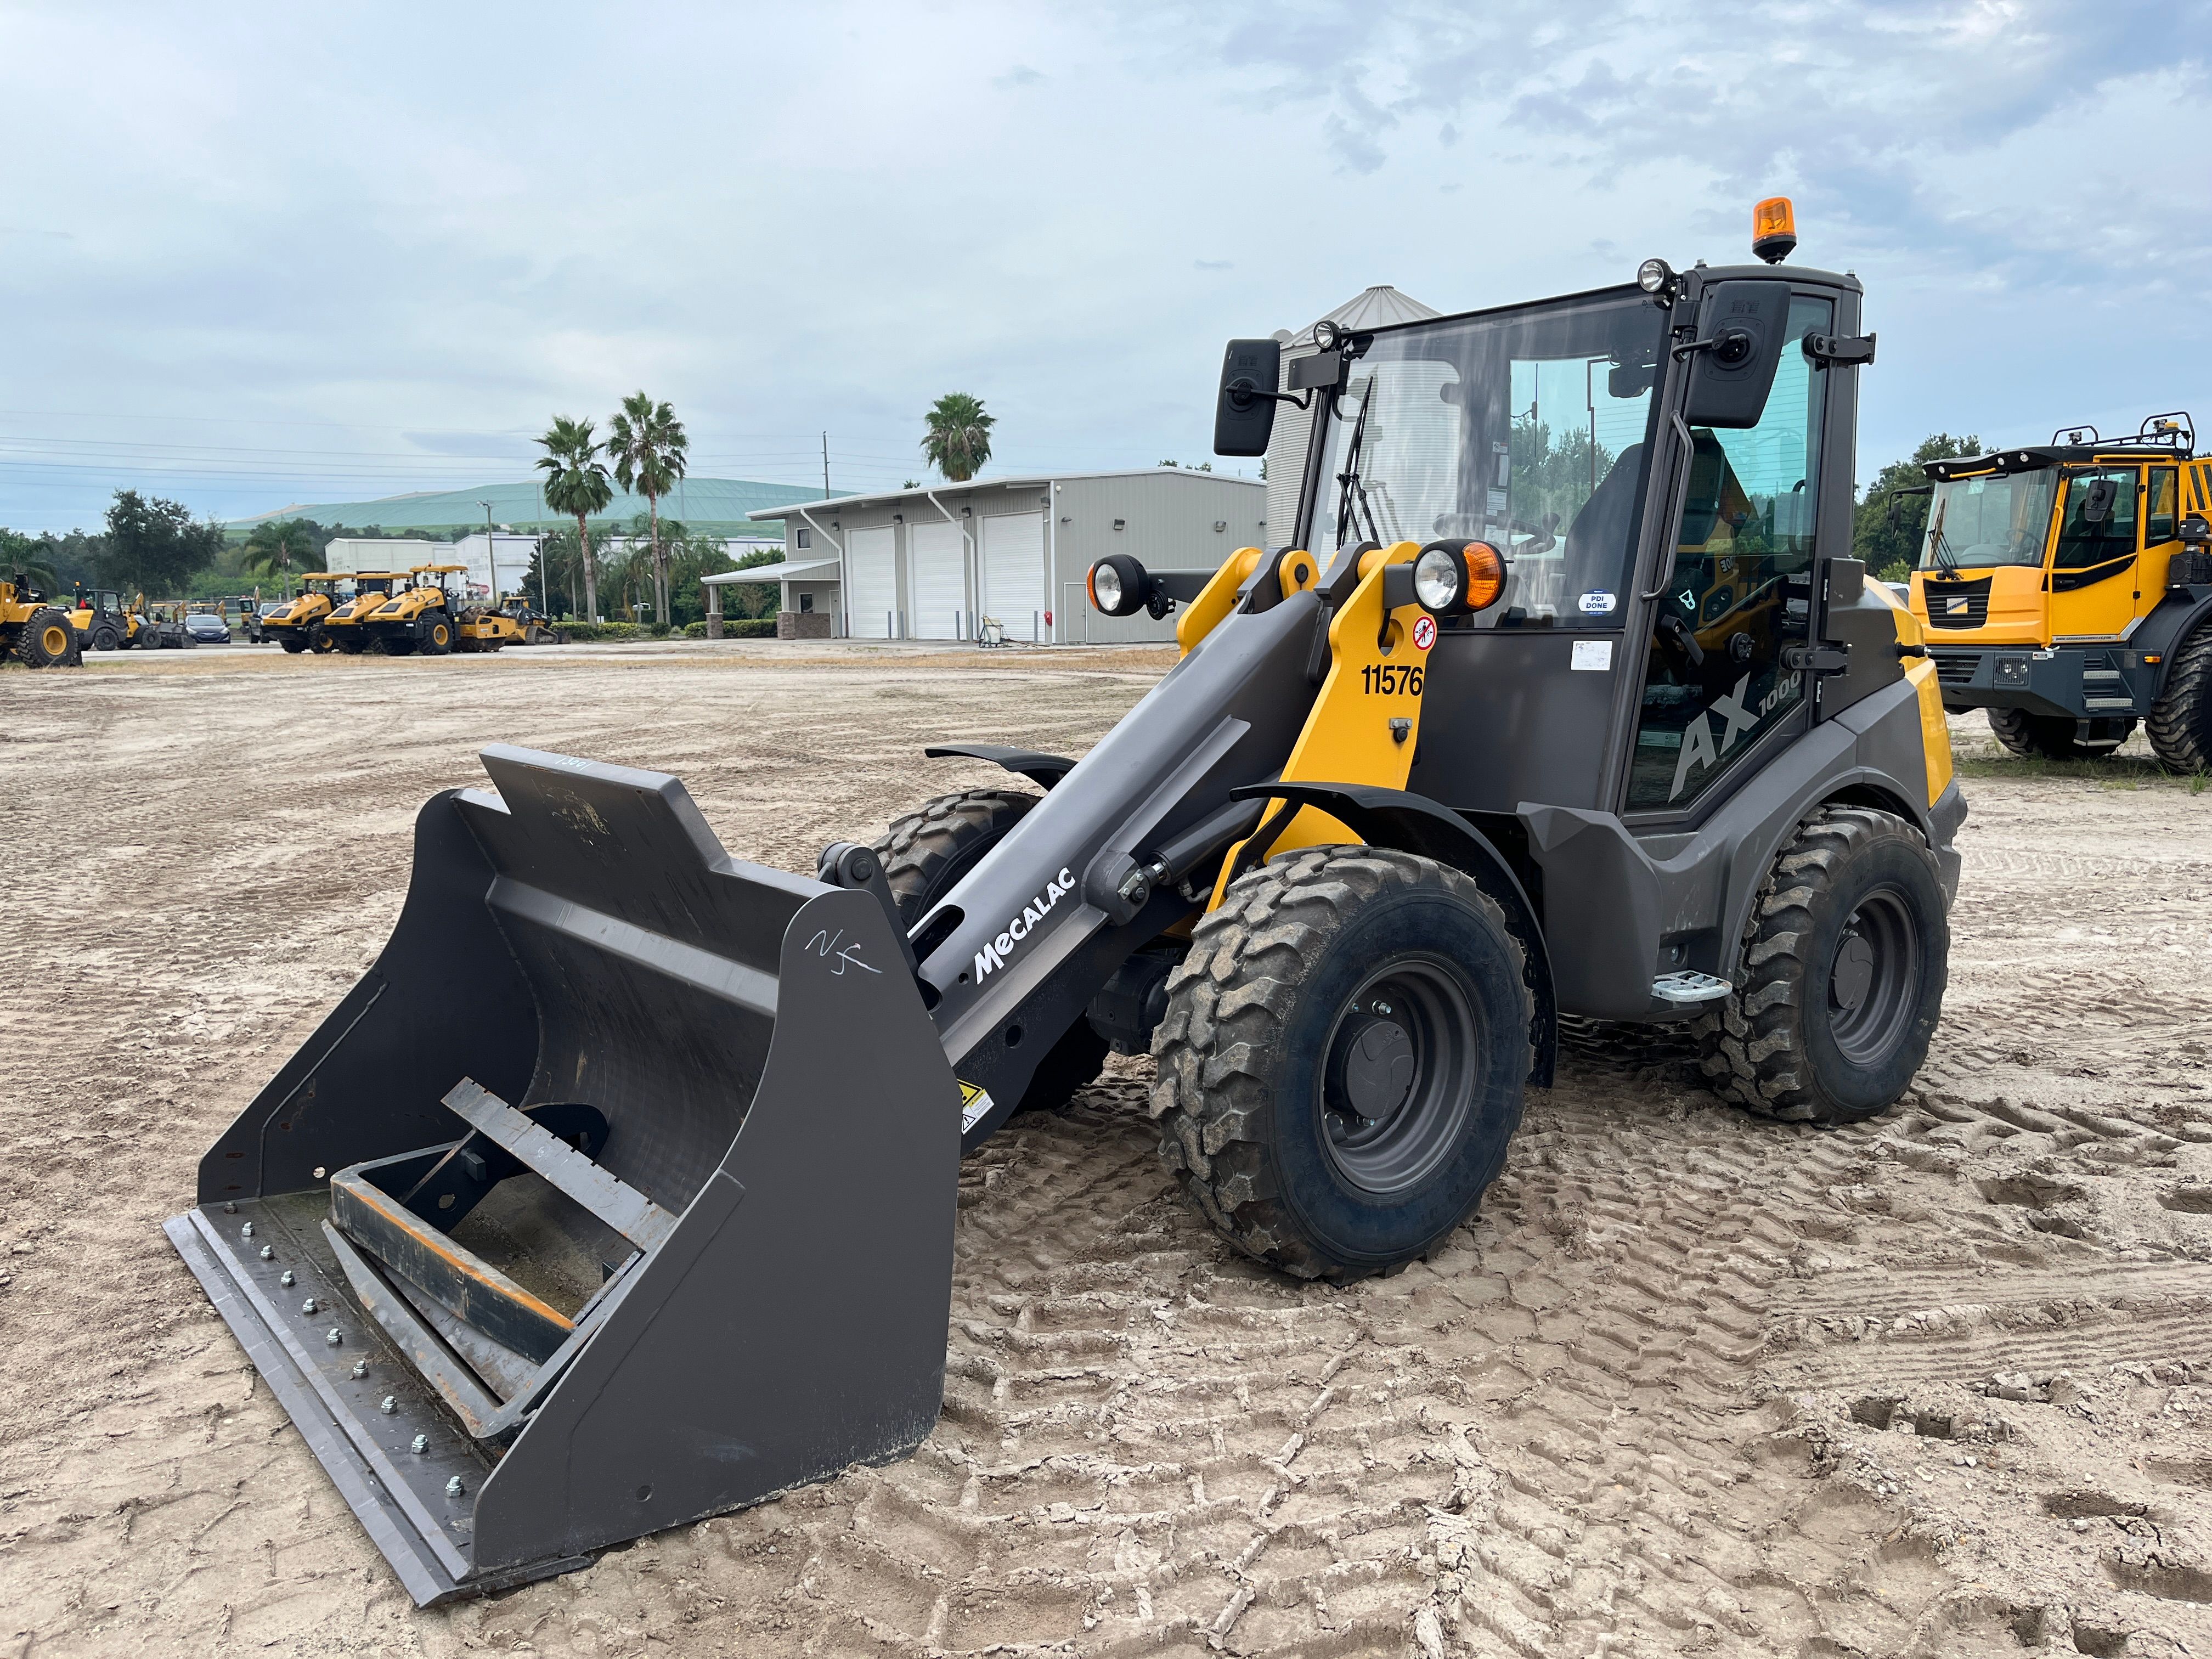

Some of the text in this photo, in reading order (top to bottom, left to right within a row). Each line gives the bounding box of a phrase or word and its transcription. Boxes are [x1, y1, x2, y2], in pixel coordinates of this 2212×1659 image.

[1361, 664, 1424, 697] 11576
[1668, 669, 1801, 803] AX 1000
